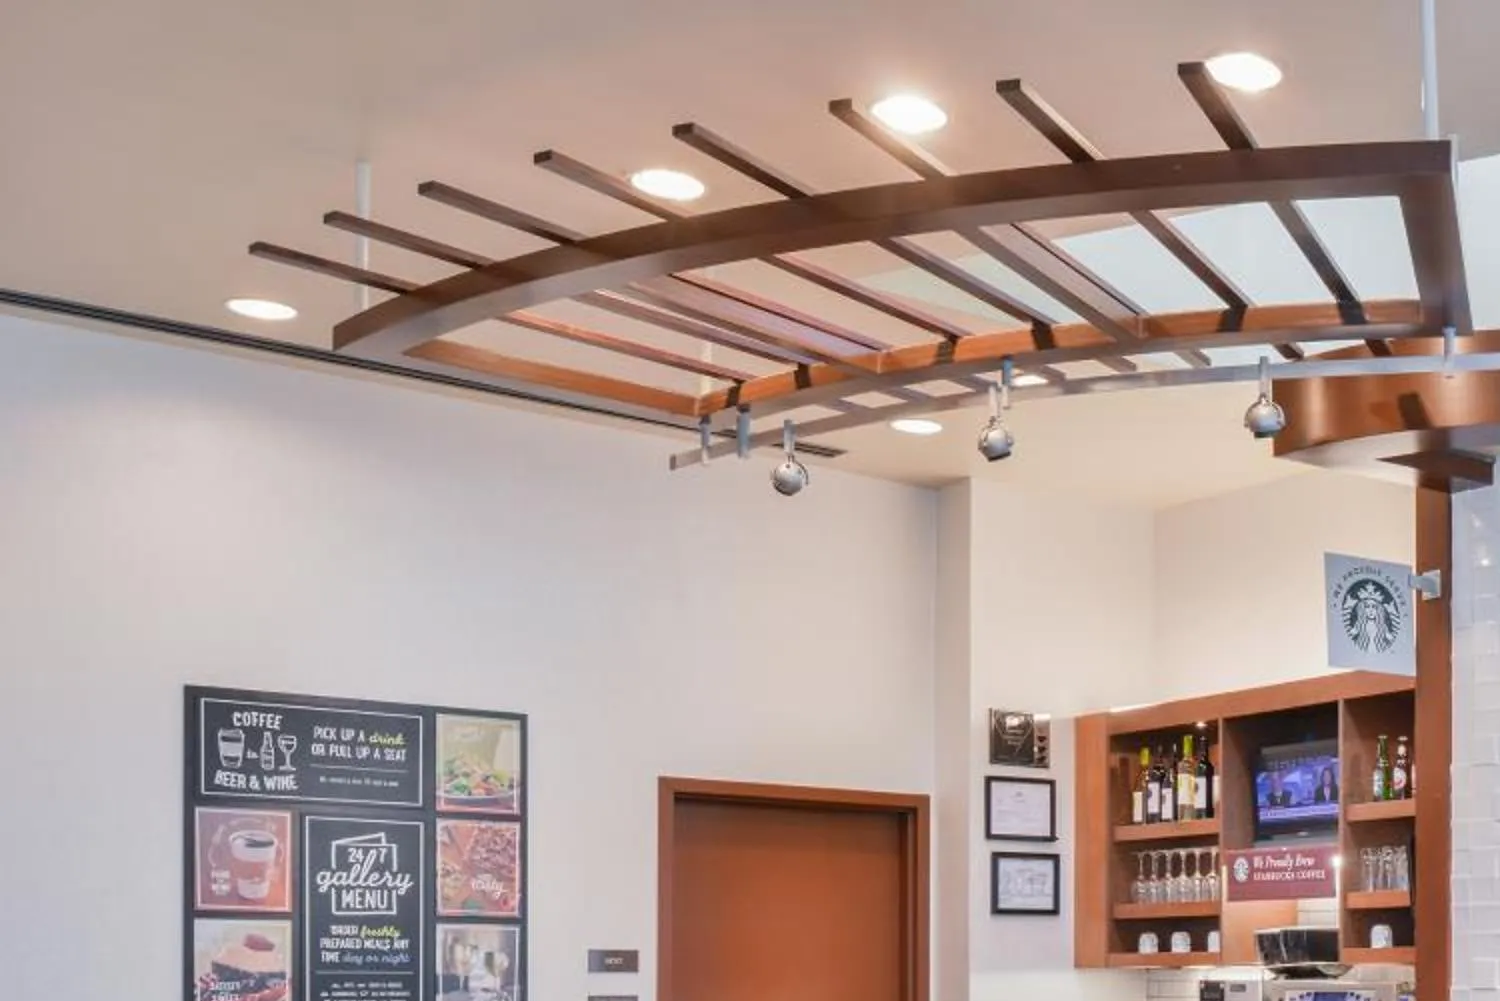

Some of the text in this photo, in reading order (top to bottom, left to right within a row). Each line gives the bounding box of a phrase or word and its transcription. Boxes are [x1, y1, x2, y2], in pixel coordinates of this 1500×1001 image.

[232, 711, 283, 730] COFFEE
[313, 725, 406, 745] PICK UP A drink
[311, 743, 406, 762] OR PULL UP A SEAT
[214, 769, 247, 789] BEER
[249, 774, 260, 790] &
[263, 774, 299, 791] WINE
[316, 848, 414, 896] gallery
[341, 888, 388, 909] MENU
